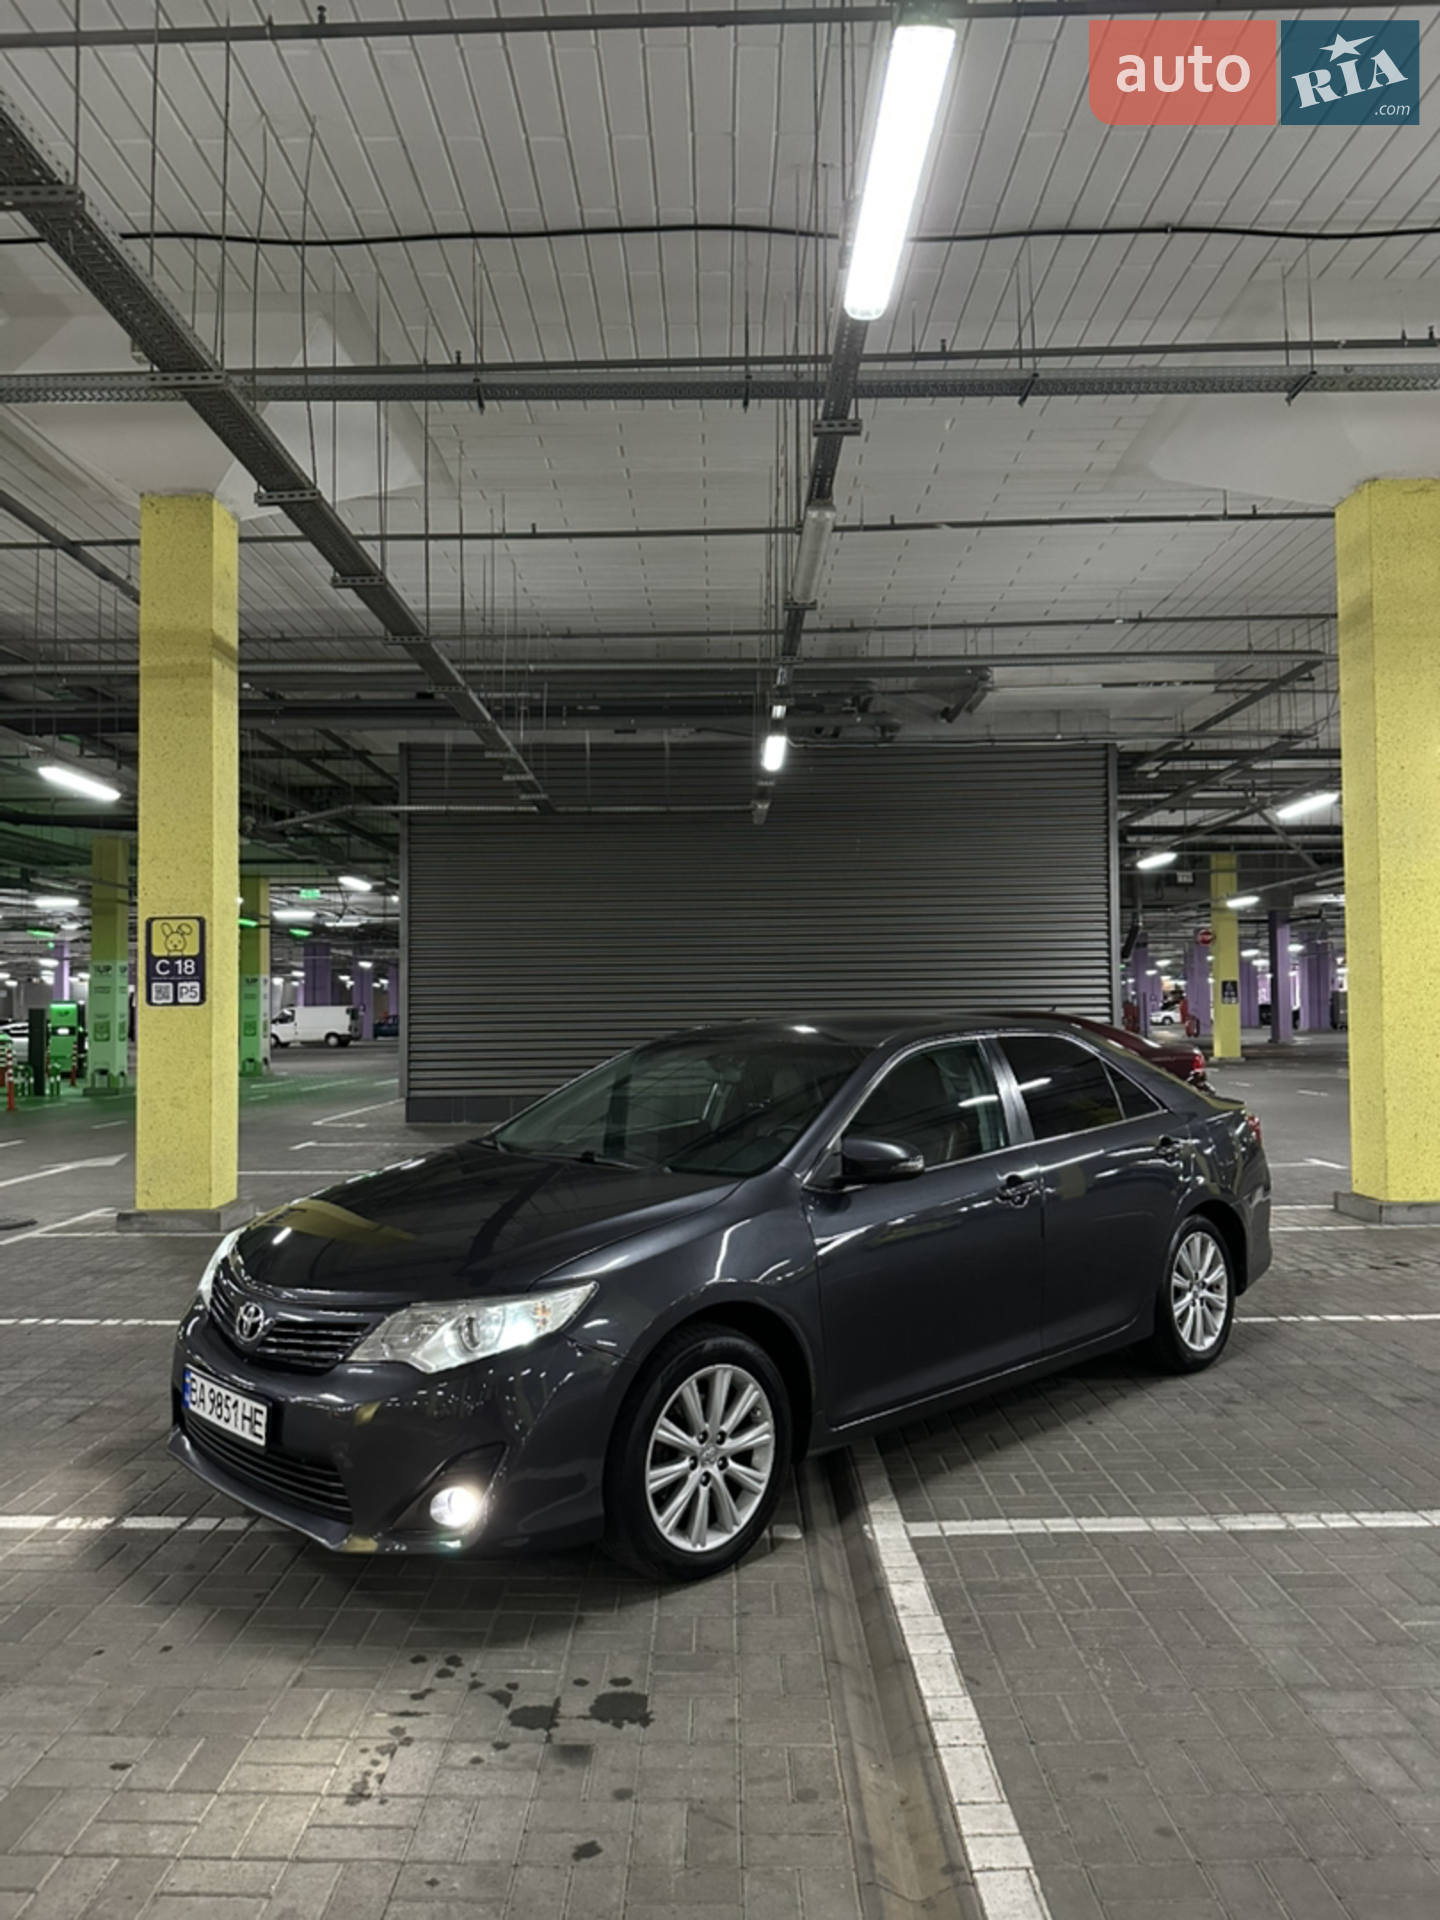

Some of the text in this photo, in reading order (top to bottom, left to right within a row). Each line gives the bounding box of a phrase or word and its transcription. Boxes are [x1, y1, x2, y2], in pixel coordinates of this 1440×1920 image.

[155, 959, 196, 976] C 18
[179, 985, 199, 1000] P5
